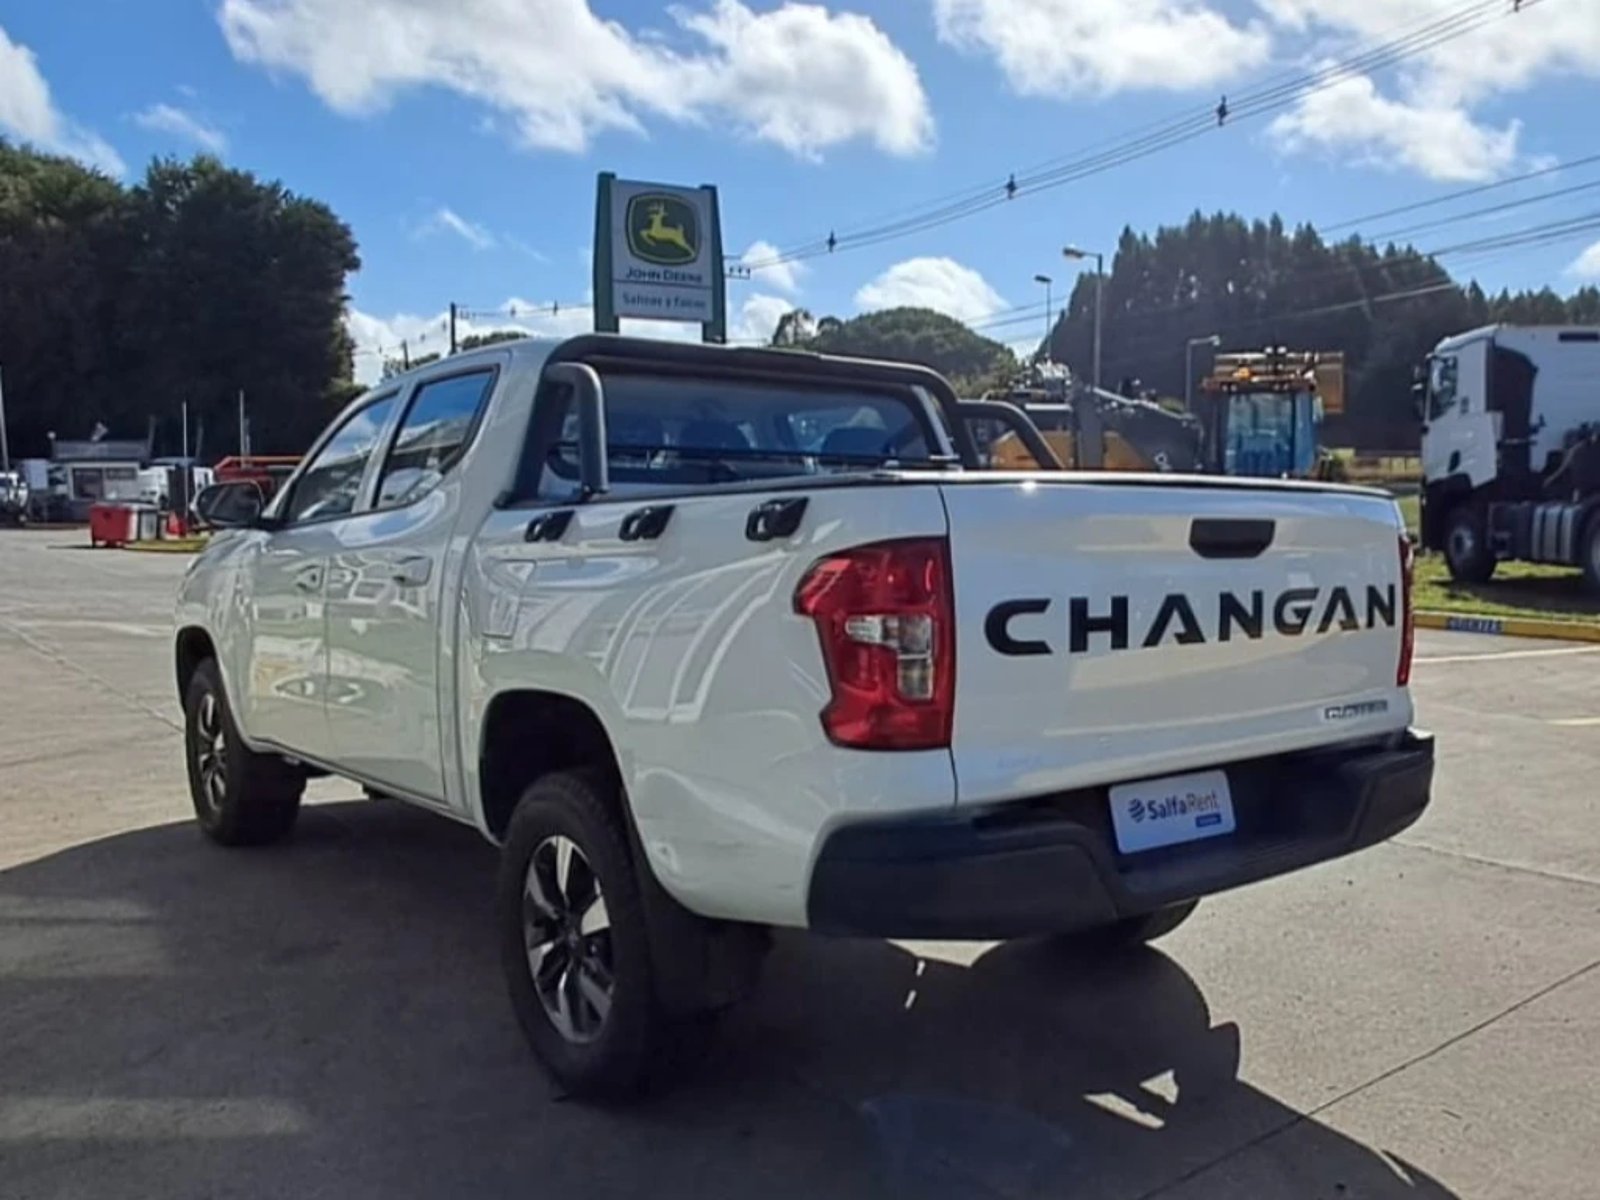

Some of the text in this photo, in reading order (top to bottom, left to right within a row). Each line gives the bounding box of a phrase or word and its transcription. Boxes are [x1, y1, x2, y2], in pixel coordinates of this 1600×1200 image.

[626, 266, 703, 283] JOHN DEERE
[983, 583, 1396, 656] CHANGAN
[1147, 790, 1220, 820] SalfaRent
